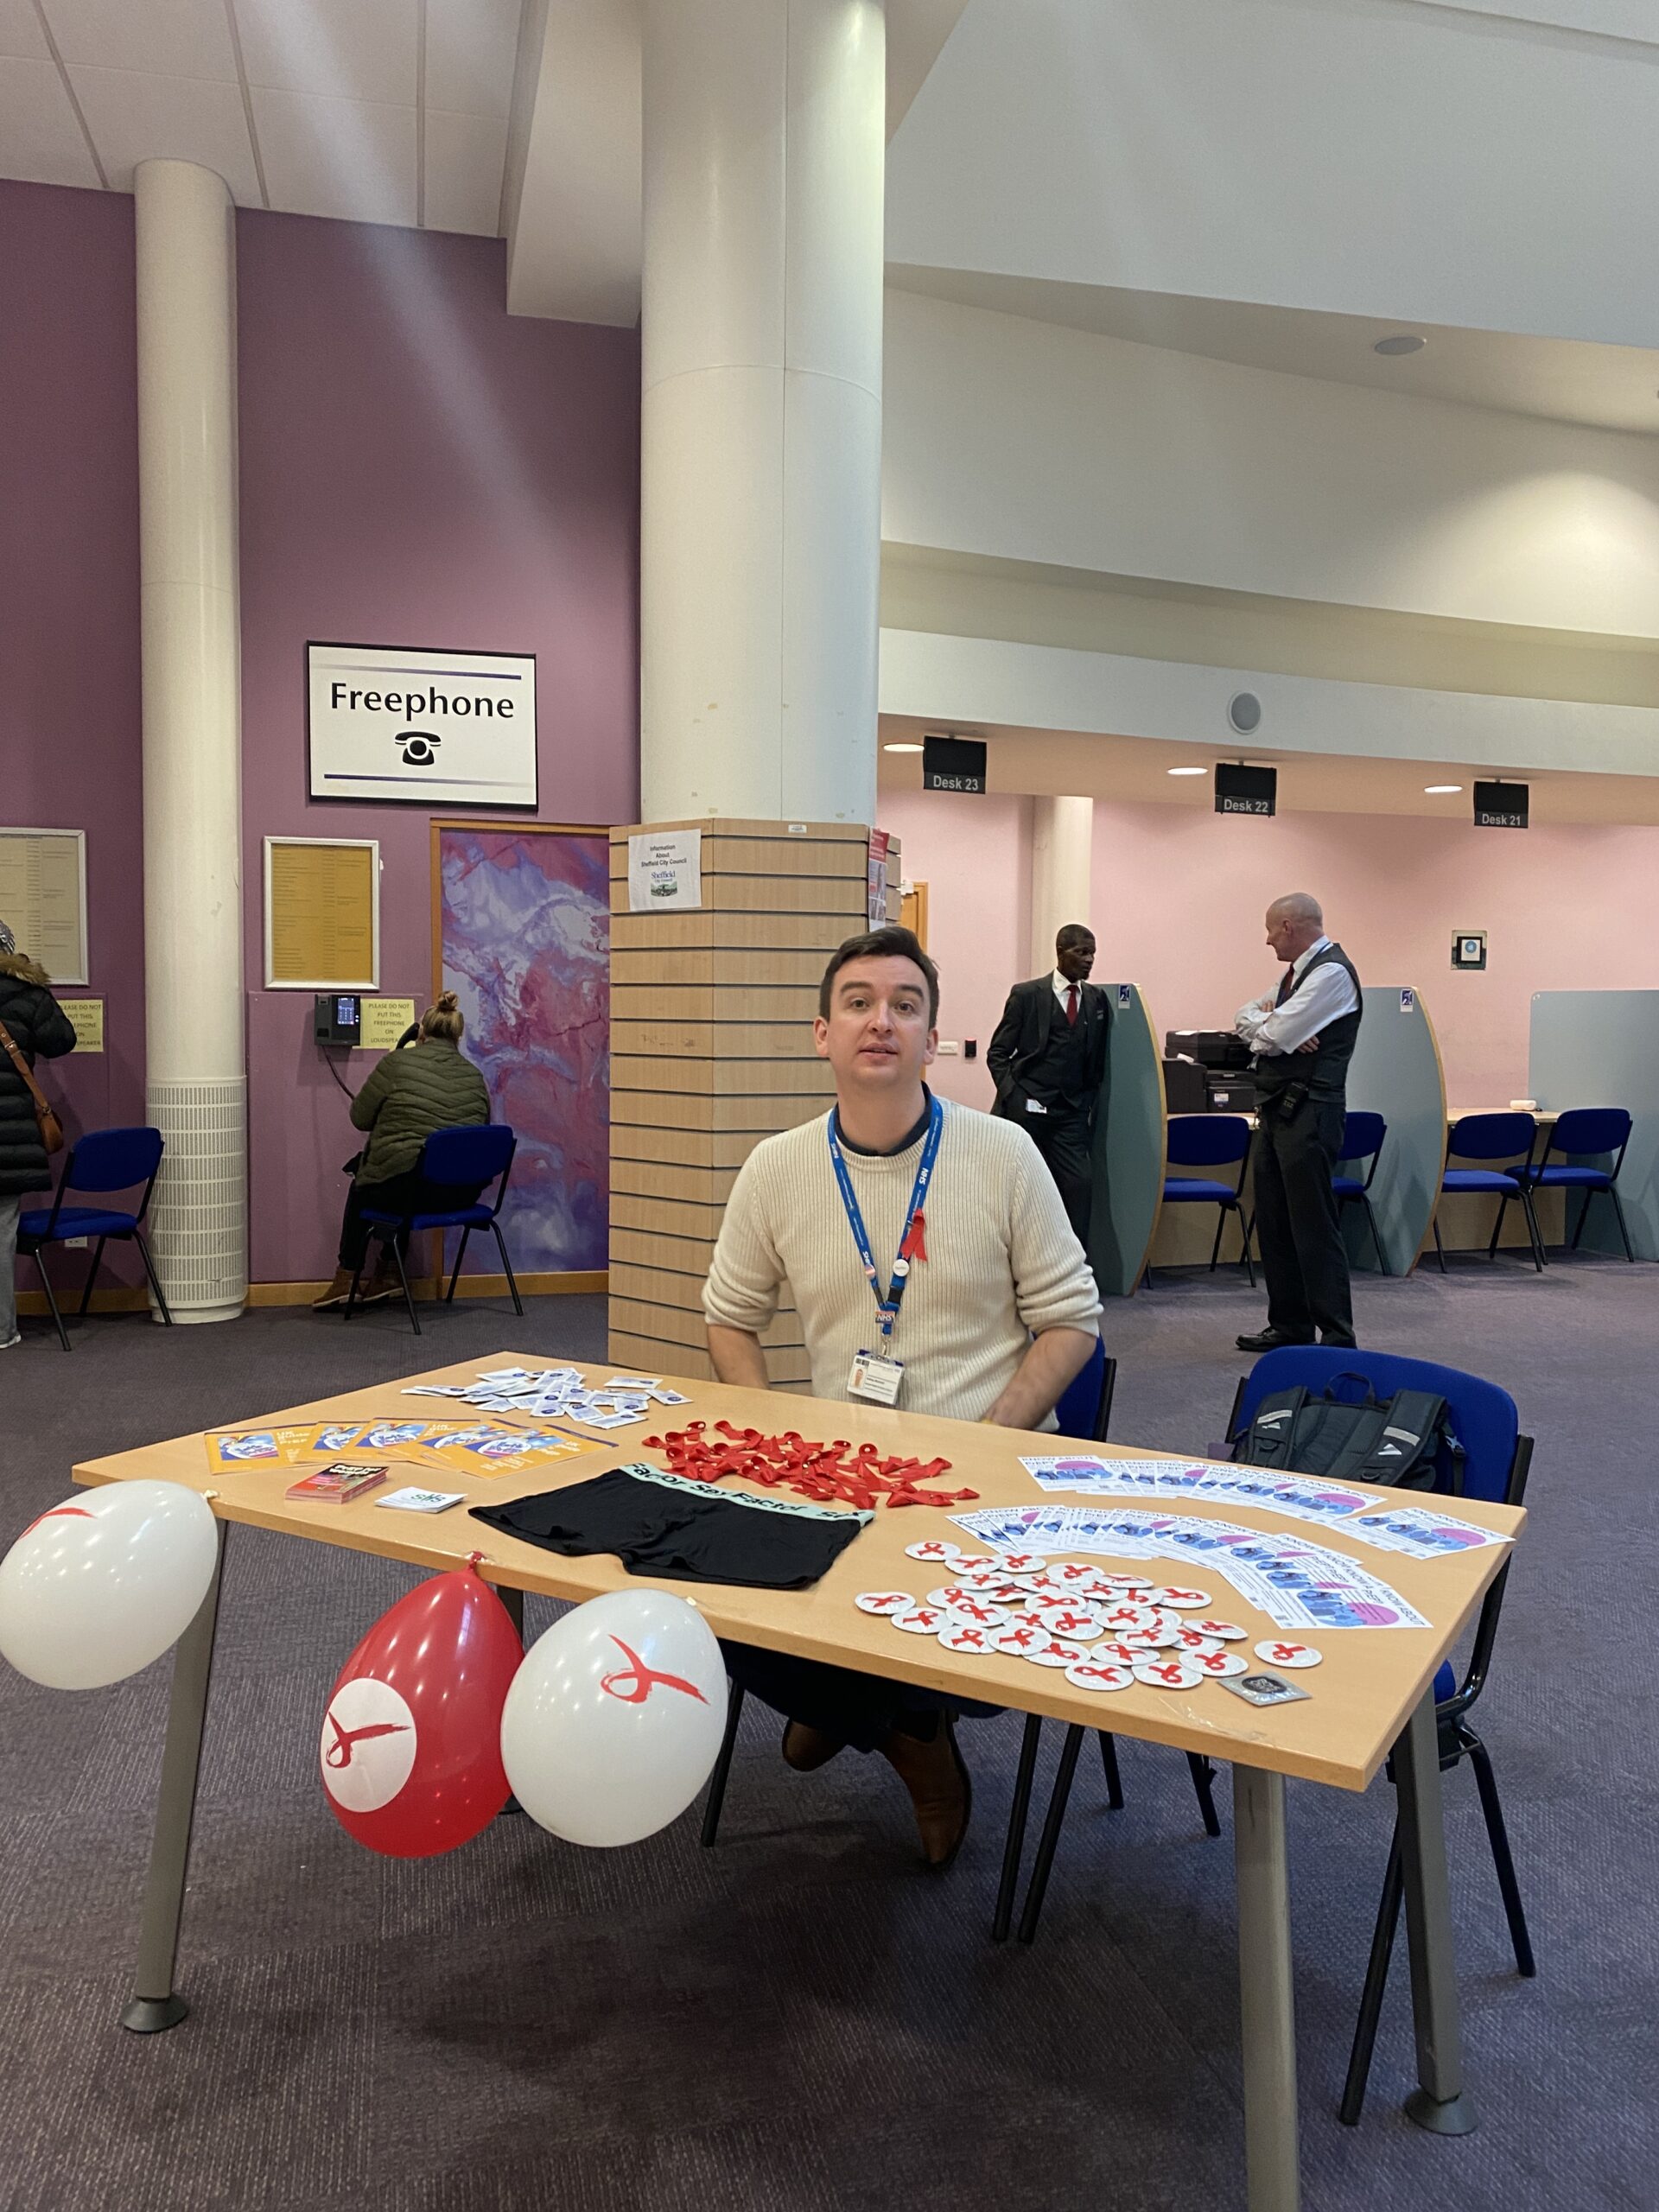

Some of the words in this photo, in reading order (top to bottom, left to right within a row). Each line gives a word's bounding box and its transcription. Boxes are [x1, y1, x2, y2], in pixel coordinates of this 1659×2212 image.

[331, 682, 514, 721] Freephone
[933, 775, 962, 790] Desk
[965, 778, 978, 791] 23
[1224, 798, 1252, 811] Desk
[1255, 801, 1268, 812] 22
[1482, 813, 1507, 825] Desk
[1510, 815, 1521, 826] 21
[918, 1167, 929, 1185] NHS
